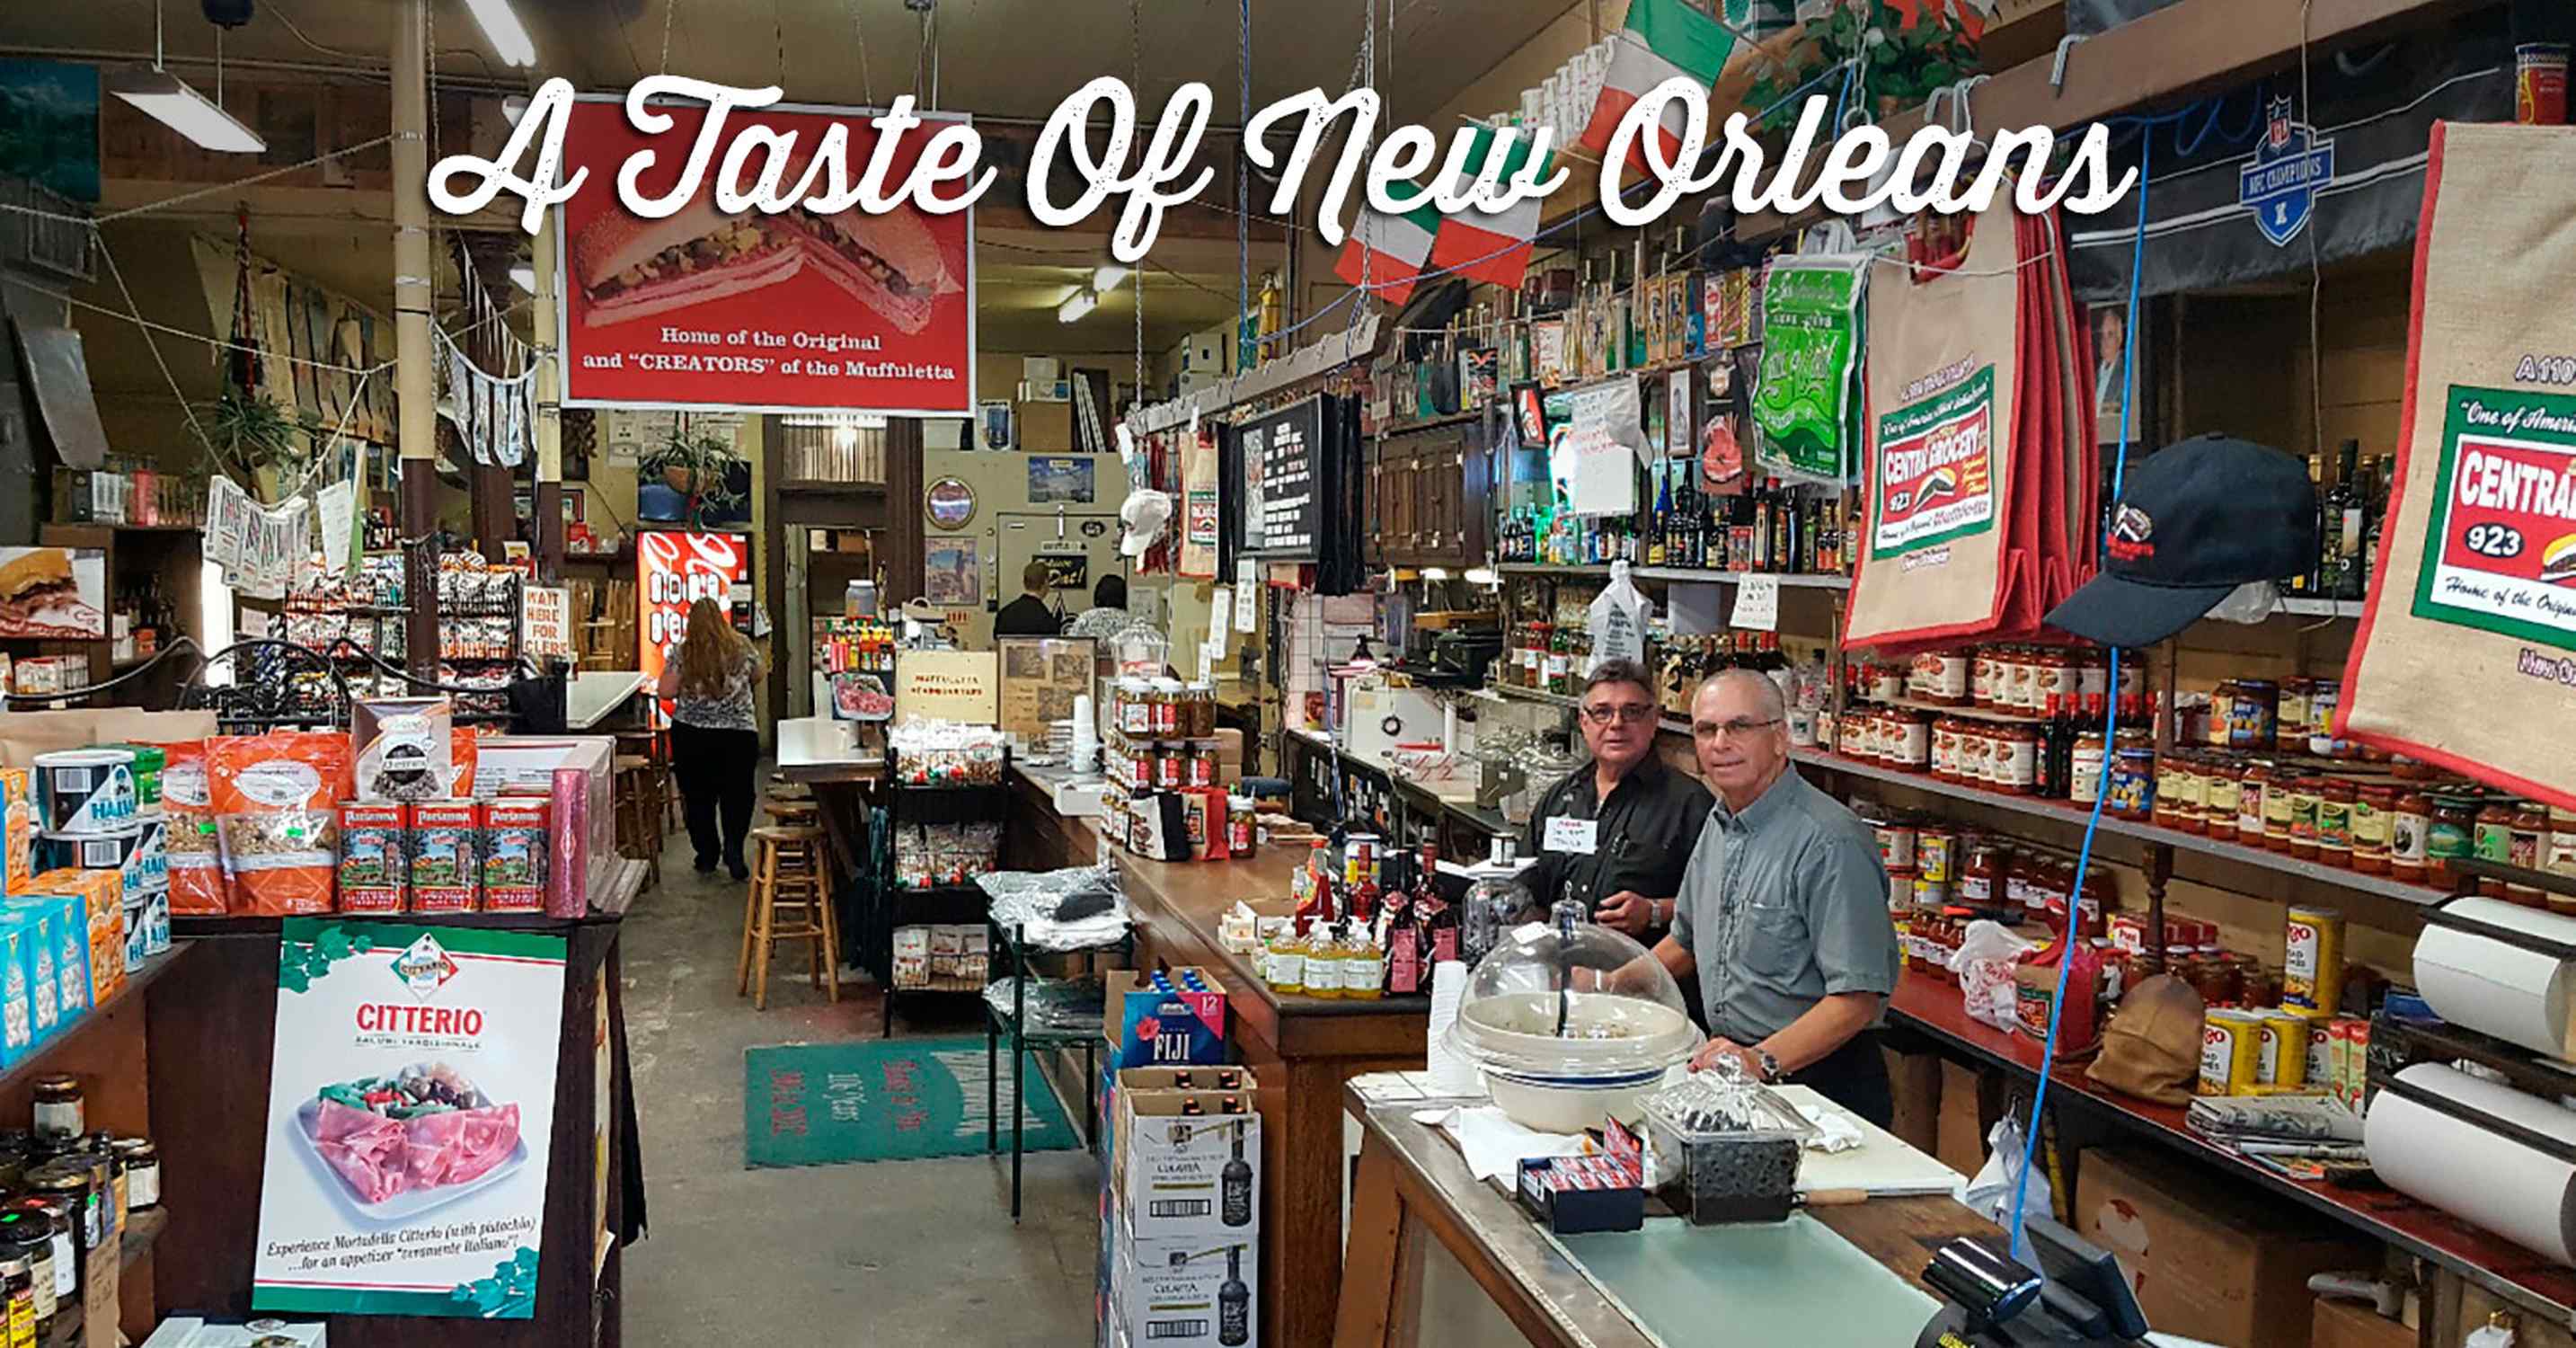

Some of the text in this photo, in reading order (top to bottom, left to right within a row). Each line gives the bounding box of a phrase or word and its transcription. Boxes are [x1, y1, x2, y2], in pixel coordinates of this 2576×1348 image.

[661, 328, 881, 351] Home of the Original
[583, 354, 955, 381] and "CREATORS" of the Muffuletta
[2501, 406, 2527, 433] of
[2460, 450, 2576, 519] CENTRA
[2468, 525, 2521, 556] 923
[2445, 576, 2489, 599] Home
[2493, 588, 2510, 607] of
[2511, 590, 2532, 607] the
[527, 607, 560, 623] HERE
[532, 625, 558, 639] FOR
[1202, 995, 1217, 1013] 12
[356, 1003, 482, 1036] CITTERIO
[1154, 1033, 1191, 1060] FIJI
[267, 1238, 331, 1256] Experience
[333, 1235, 395, 1250] Mortadella
[399, 1228, 443, 1244] Citterio
[478, 1217, 536, 1237] pistachio)
[321, 1257, 337, 1268] an
[340, 1249, 394, 1269] appetizer
